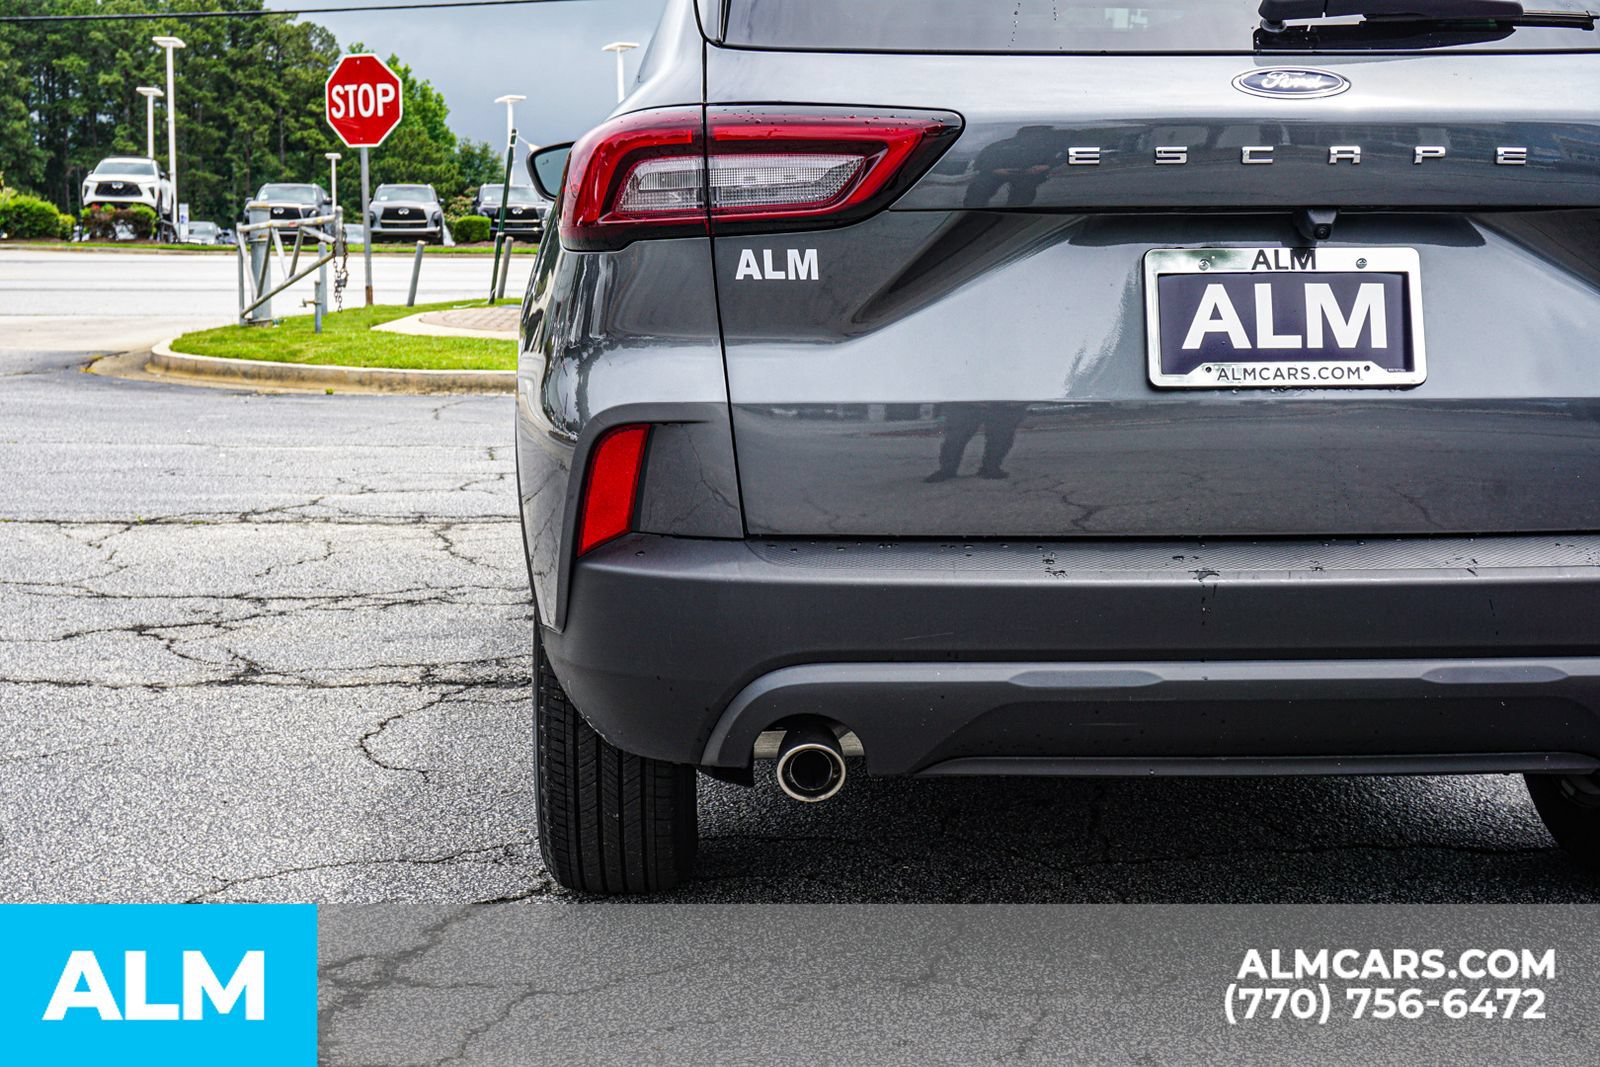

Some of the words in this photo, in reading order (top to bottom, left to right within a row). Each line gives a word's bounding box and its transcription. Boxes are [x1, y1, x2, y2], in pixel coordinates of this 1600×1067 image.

[1261, 71, 1332, 89] Ford
[331, 83, 396, 119] STOP
[1067, 145, 1528, 166] ESCAPE
[735, 248, 819, 280] ALM
[1251, 249, 1317, 270] ALM
[1181, 282, 1388, 349] ALM
[1216, 365, 1362, 381] ALMCARS.COM
